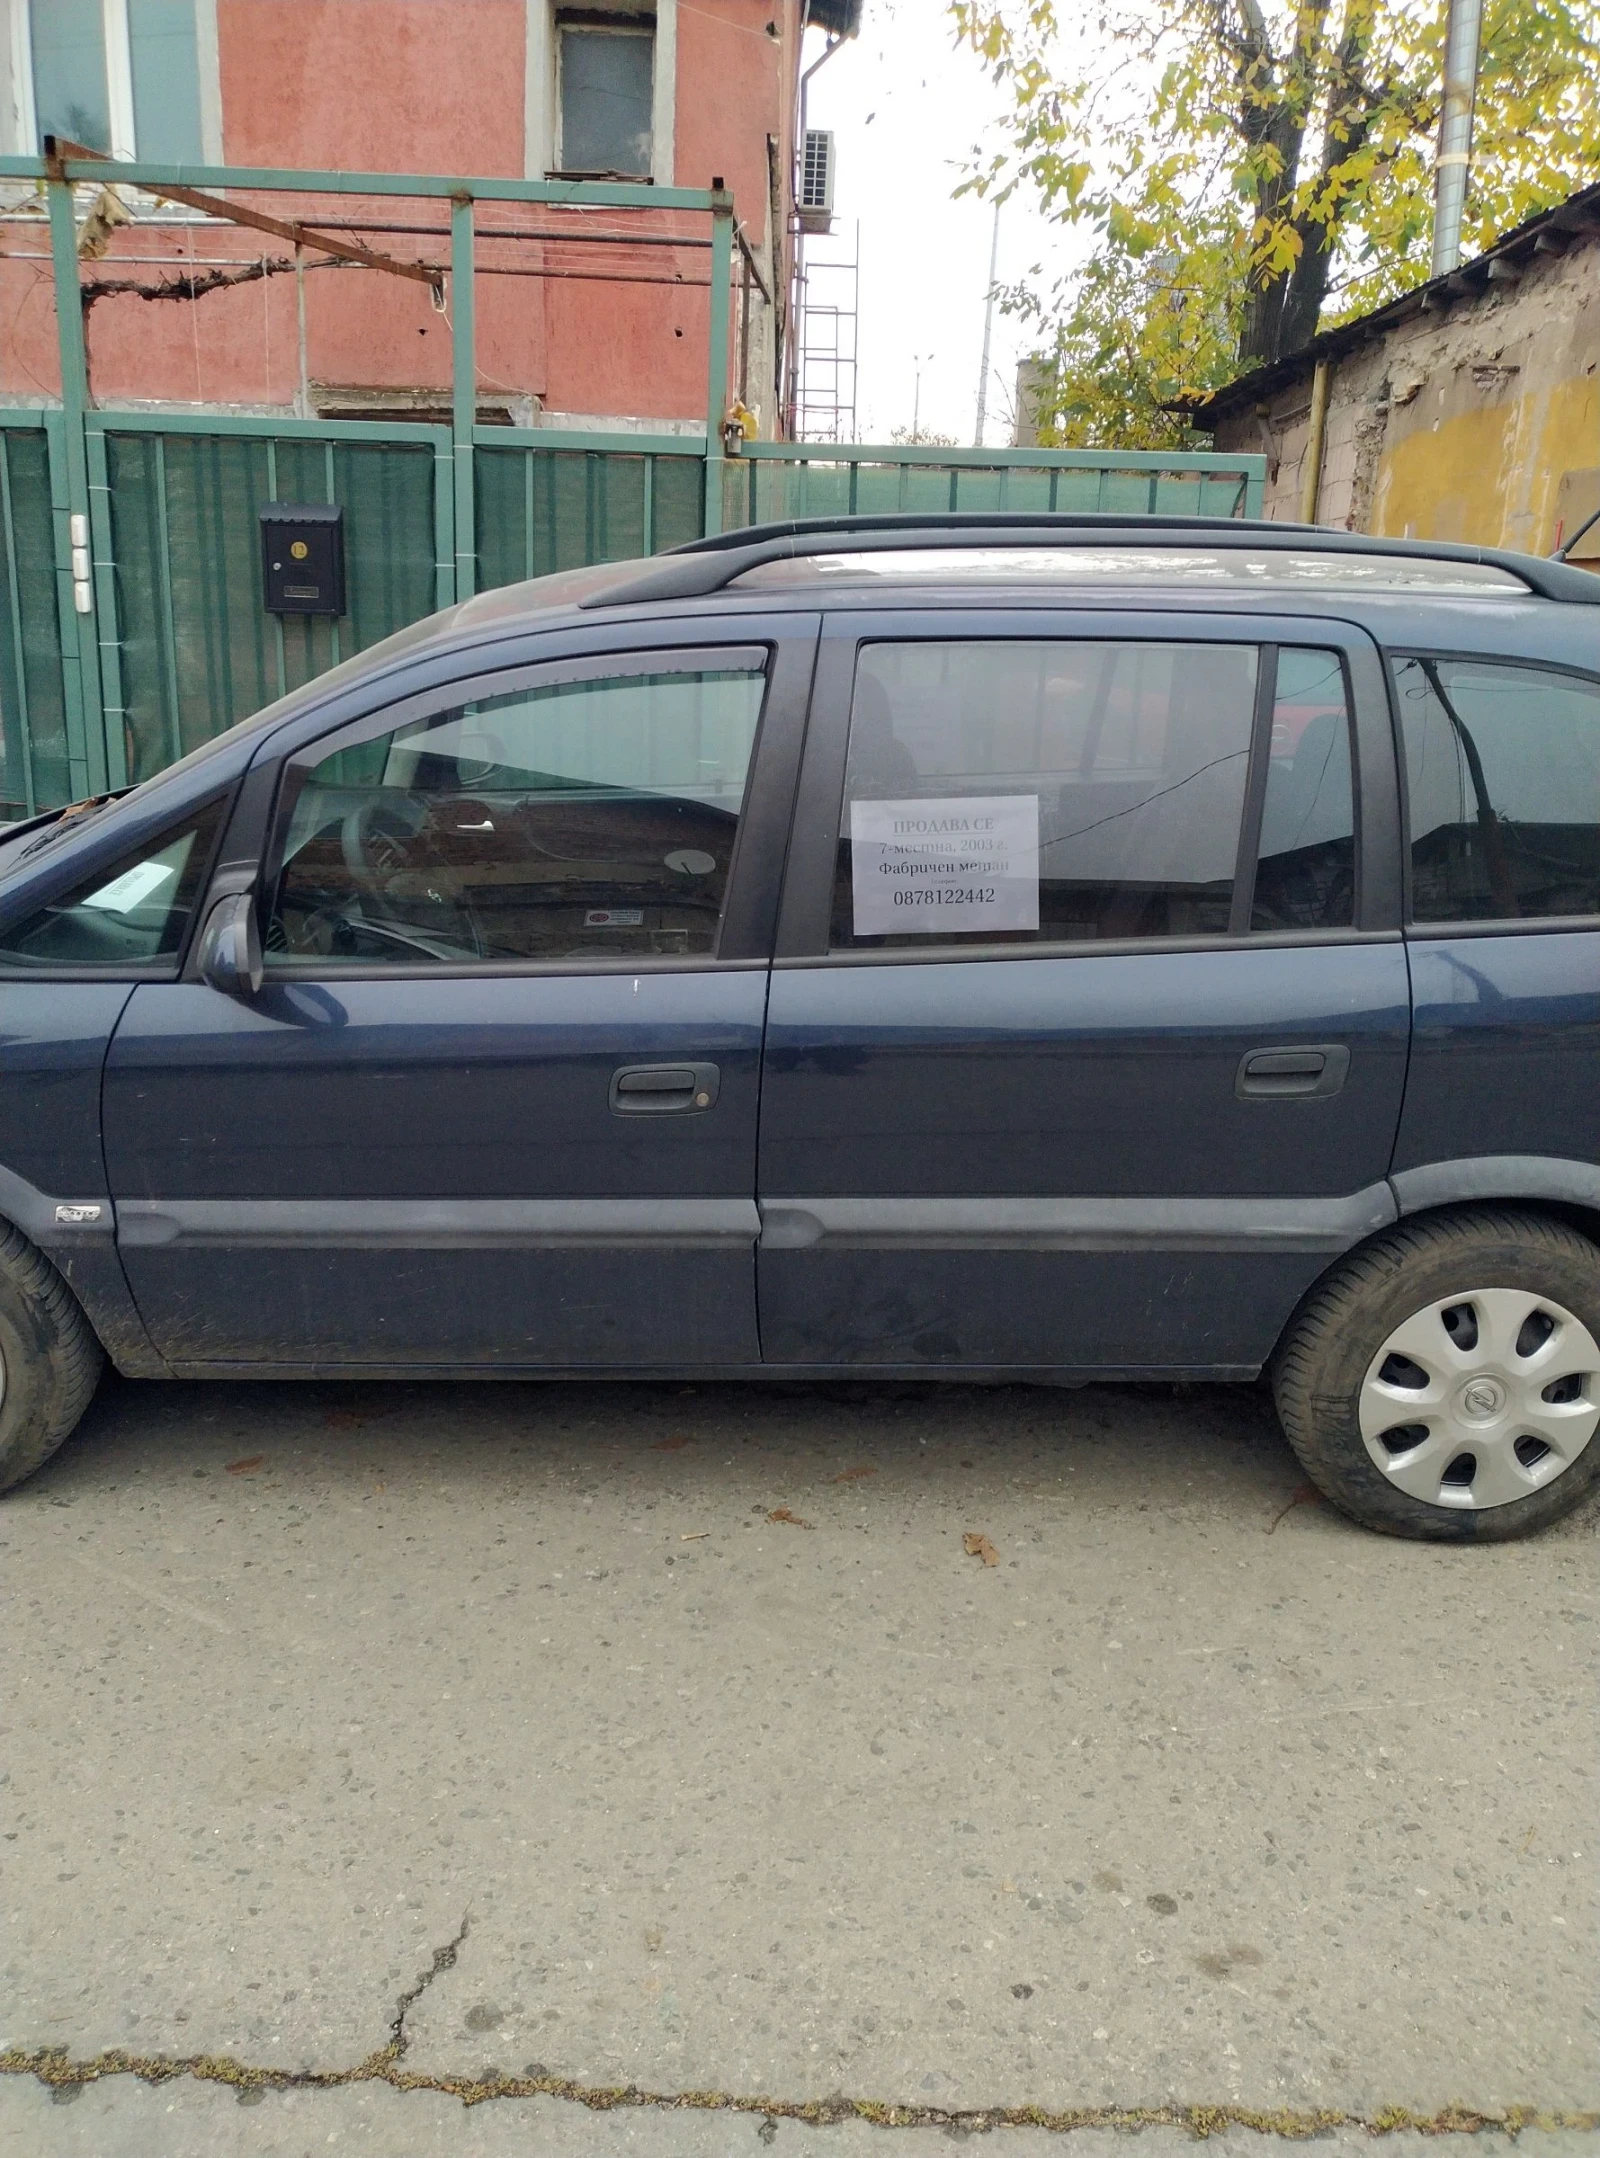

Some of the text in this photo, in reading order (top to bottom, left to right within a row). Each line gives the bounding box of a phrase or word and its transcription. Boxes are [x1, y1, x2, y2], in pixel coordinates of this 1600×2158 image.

[894, 818, 994, 834] ПРОДАВА СЕ
[961, 839, 993, 852] 2003
[879, 861, 1009, 877] Фабричен метан
[894, 888, 995, 906] 0878122442
